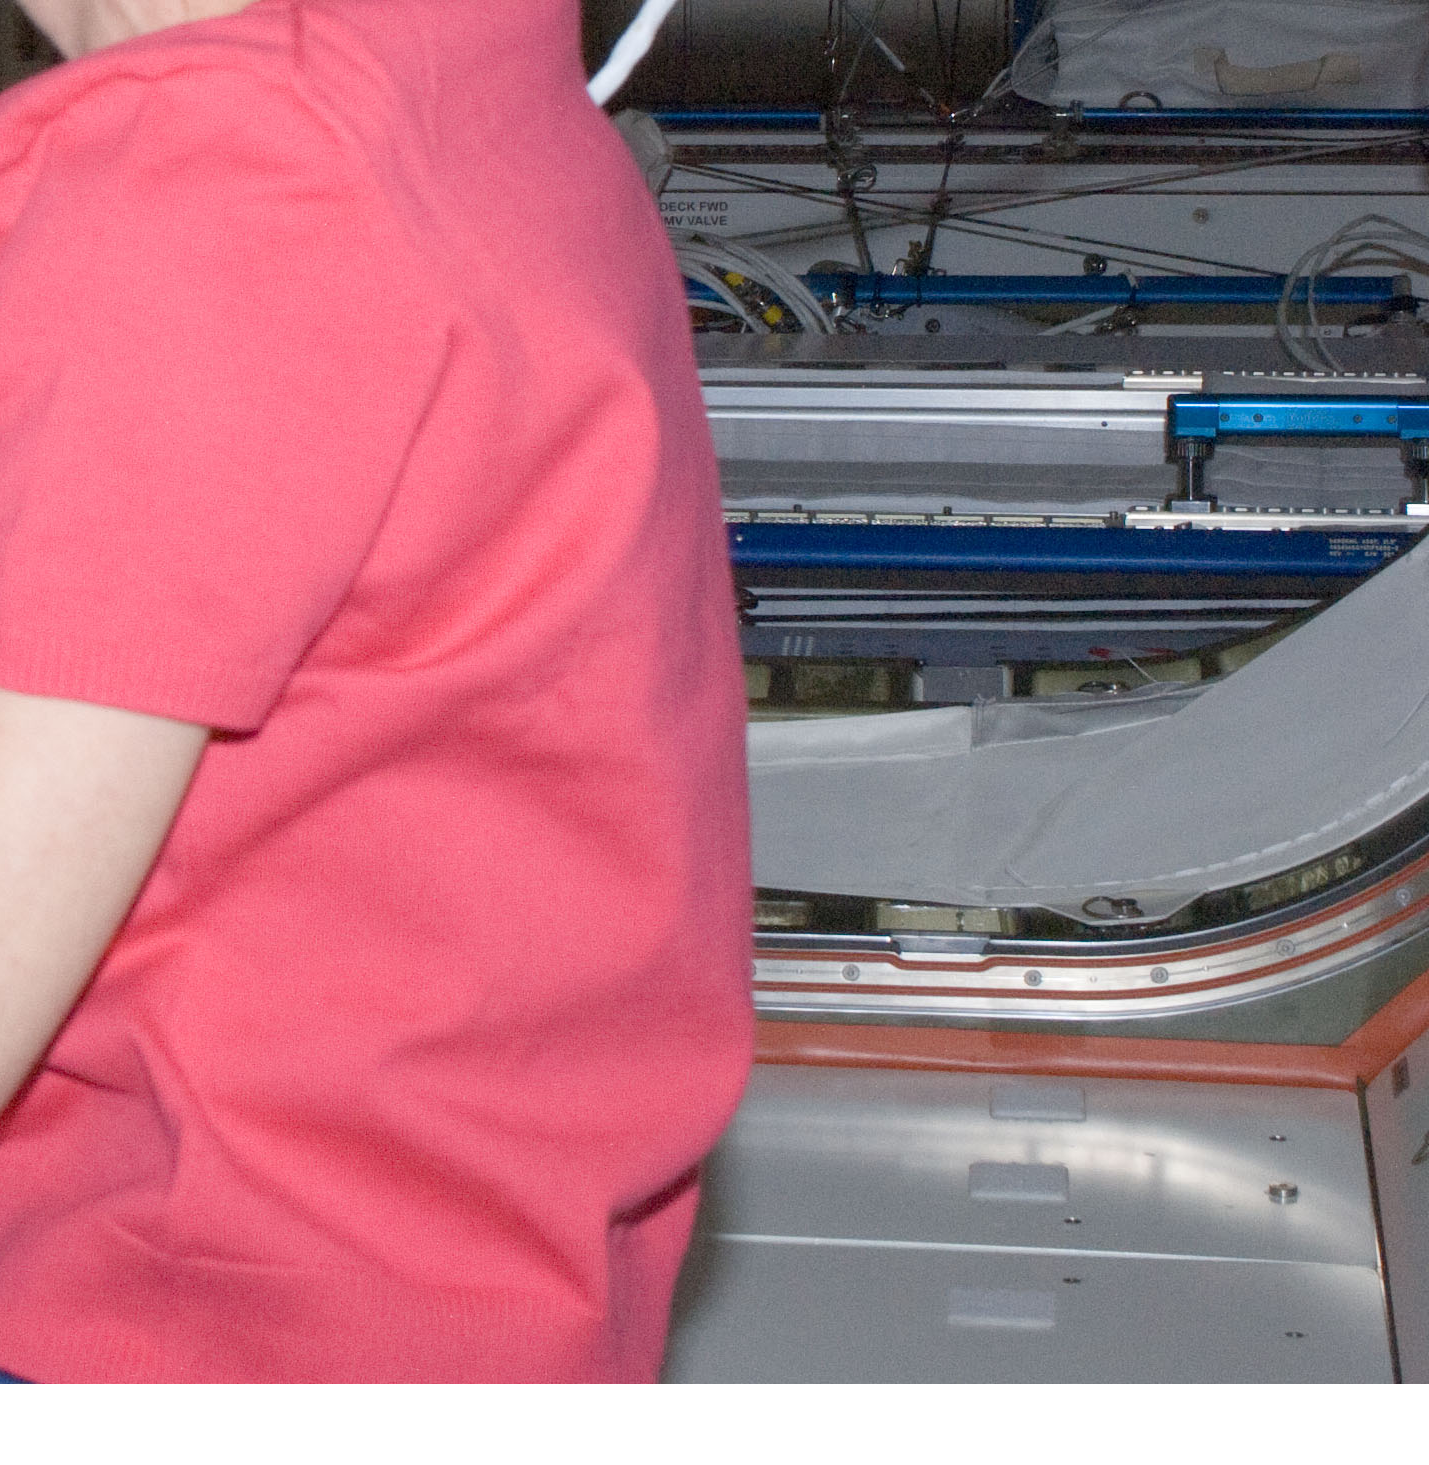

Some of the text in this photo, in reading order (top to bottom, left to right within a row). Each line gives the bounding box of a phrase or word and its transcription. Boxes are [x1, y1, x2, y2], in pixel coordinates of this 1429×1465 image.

[659, 201, 729, 212] DECK FWD
[687, 215, 728, 226] VALVE
